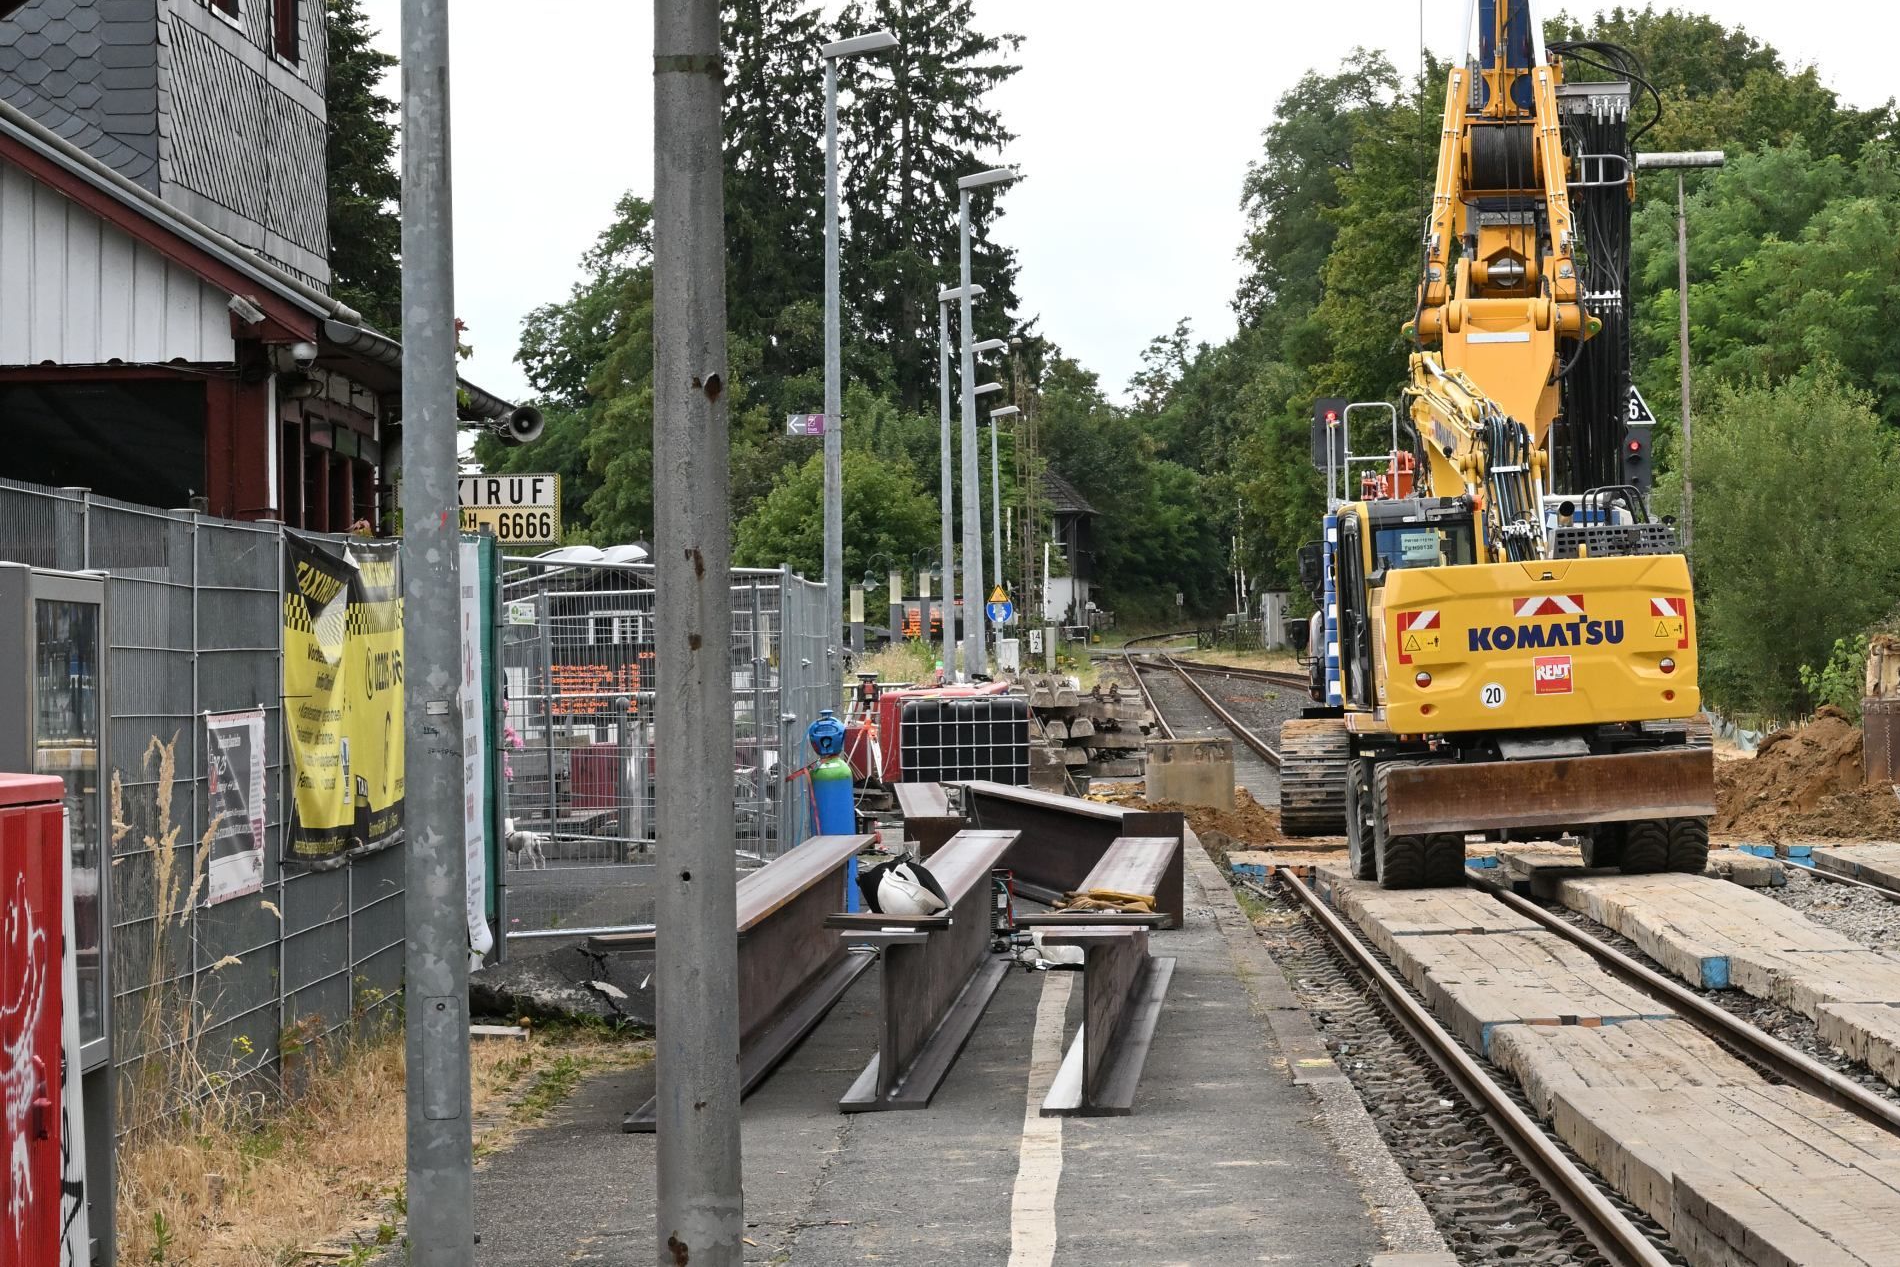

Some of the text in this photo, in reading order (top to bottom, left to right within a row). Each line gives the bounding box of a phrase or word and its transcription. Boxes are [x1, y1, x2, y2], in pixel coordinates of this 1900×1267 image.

[499, 512, 550, 539] 6666
[1032, 631, 1040, 640] 14
[1468, 615, 1624, 652] KOMATSU
[1033, 641, 1039, 650] 2
[1536, 663, 1571, 681] RENT
[1485, 687, 1502, 704] 20
